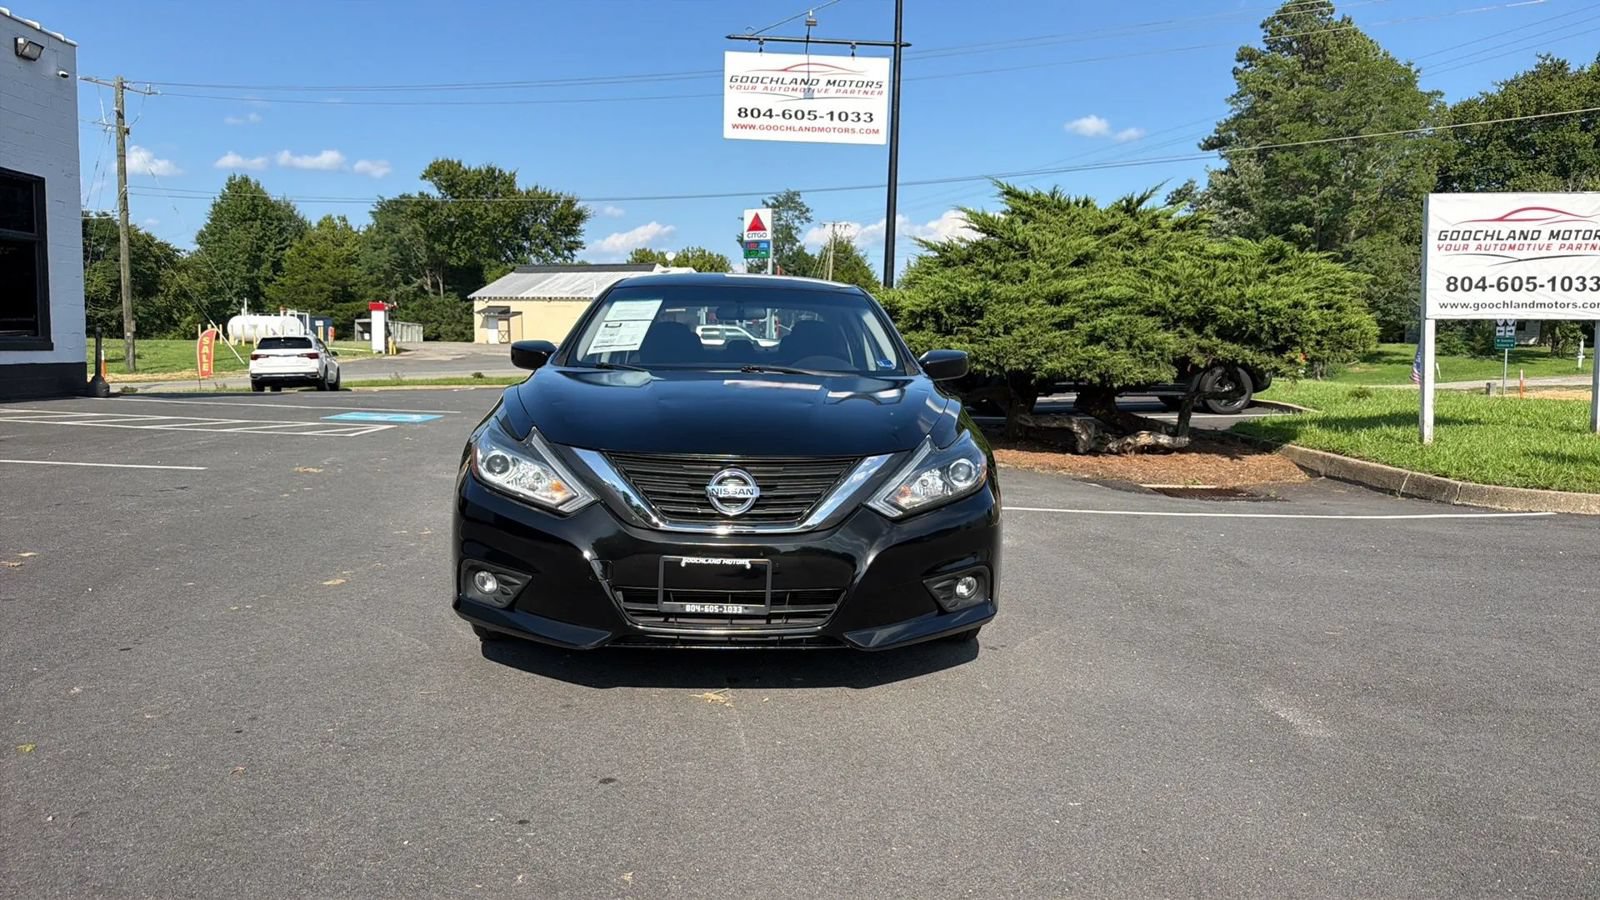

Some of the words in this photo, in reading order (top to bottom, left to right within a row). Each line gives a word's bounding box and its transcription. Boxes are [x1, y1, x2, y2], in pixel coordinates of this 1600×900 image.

[729, 75, 820, 86] GOOCHLAND
[826, 79, 884, 89] MOTORS
[762, 85, 831, 94] AUTOMOTIVE
[835, 88, 884, 96] PARTNER
[737, 107, 874, 123] 804-605-1033
[731, 123, 880, 135] WWW.GOOCHLANDMOTORS.COM
[1437, 229, 1542, 241] GOOCHLAND
[1437, 243, 1470, 252] YOUR
[1475, 243, 1553, 251] AUTOMOTIVE
[1558, 243, 1600, 251] PARTN
[1445, 275, 1600, 293] 804-605-1033
[202, 336, 210, 371] SALE
[711, 487, 755, 496] NISSAN
[685, 604, 743, 614] 804-605-1033
